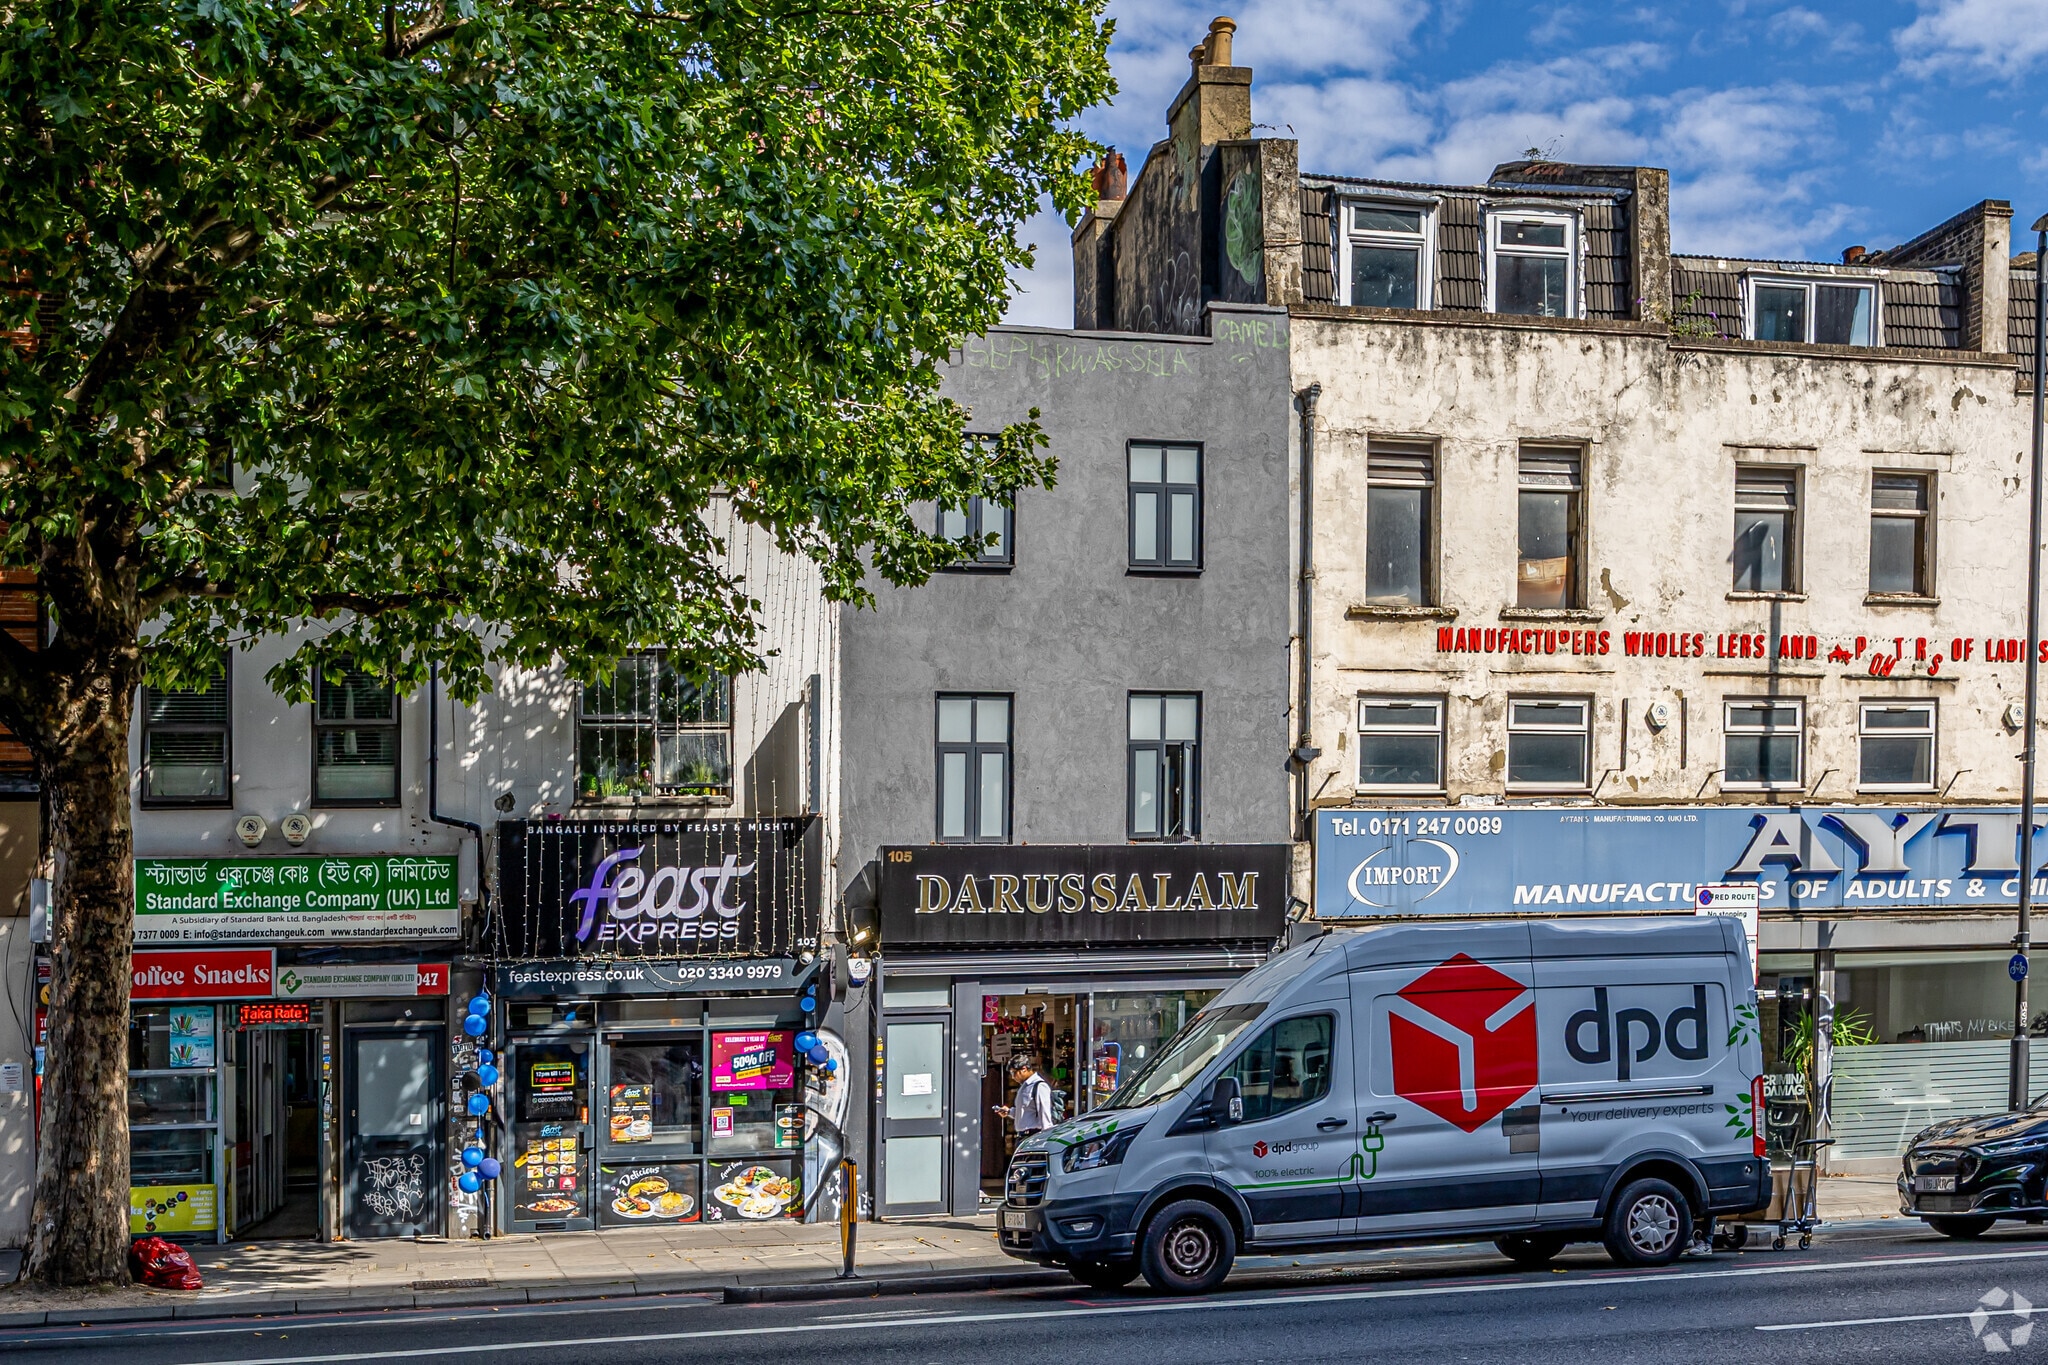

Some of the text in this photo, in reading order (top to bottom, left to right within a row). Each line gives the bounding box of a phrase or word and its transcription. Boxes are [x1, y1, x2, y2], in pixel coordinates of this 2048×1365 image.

[1779, 634, 1817, 660] AND
[1950, 637, 1974, 662] OF
[1985, 638, 2048, 663] LADIS
[527, 822, 795, 834] BANGALI INSPIRED BY FEAST & MISHTI
[1369, 817, 1410, 835] 0171
[1416, 817, 1450, 835] 247
[1454, 816, 1502, 835] 0089
[1593, 815, 1651, 823] MANUFACTURING
[1668, 815, 1682, 823] (UK)
[1684, 814, 1698, 822] LTD.
[888, 851, 913, 864] 105
[1364, 866, 1441, 885] IMPORT
[146, 888, 450, 911] Standard Exchange Company (UK) Ltd
[569, 844, 756, 943] feast
[915, 872, 1259, 914] DARUSSALAM
[1513, 881, 1777, 904] MANUFACTUS
[1791, 880, 1829, 899] OF
[1844, 879, 1951, 899] ADULTS
[1966, 879, 1985, 897] &
[1714, 893, 1756, 901] RED ROUTE
[179, 917, 218, 925] Subsidiary
[266, 915, 285, 923] Bank
[138, 930, 157, 939] 7377
[159, 930, 180, 939] 0009
[183, 929, 192, 939] E:
[194, 927, 325, 940] info@standardexchangeuk.com
[331, 925, 457, 938] www.standardexchangeuk.com
[597, 921, 740, 944] EXPRESS
[797, 937, 817, 947] 103
[134, 964, 270, 986] offee Snacks
[333, 975, 362, 983] EXCHANGE
[363, 974, 390, 983] COMPANY
[391, 974, 404, 982] (UK)
[405, 974, 415, 982] LTD
[508, 964, 782, 985] feastexpress.co.uk 020 3340 9979
[243, 1008, 302, 1020] Taka Rate
[1564, 984, 1709, 1082] dpd
[733, 1050, 775, 1069] 50% OFF
[1763, 1074, 1806, 1085] CRIMINA
[1570, 1103, 1714, 1123] Your delivery experts
[619, 1166, 660, 1187] Delicious
[1254, 1166, 1315, 1179] 100% electric
